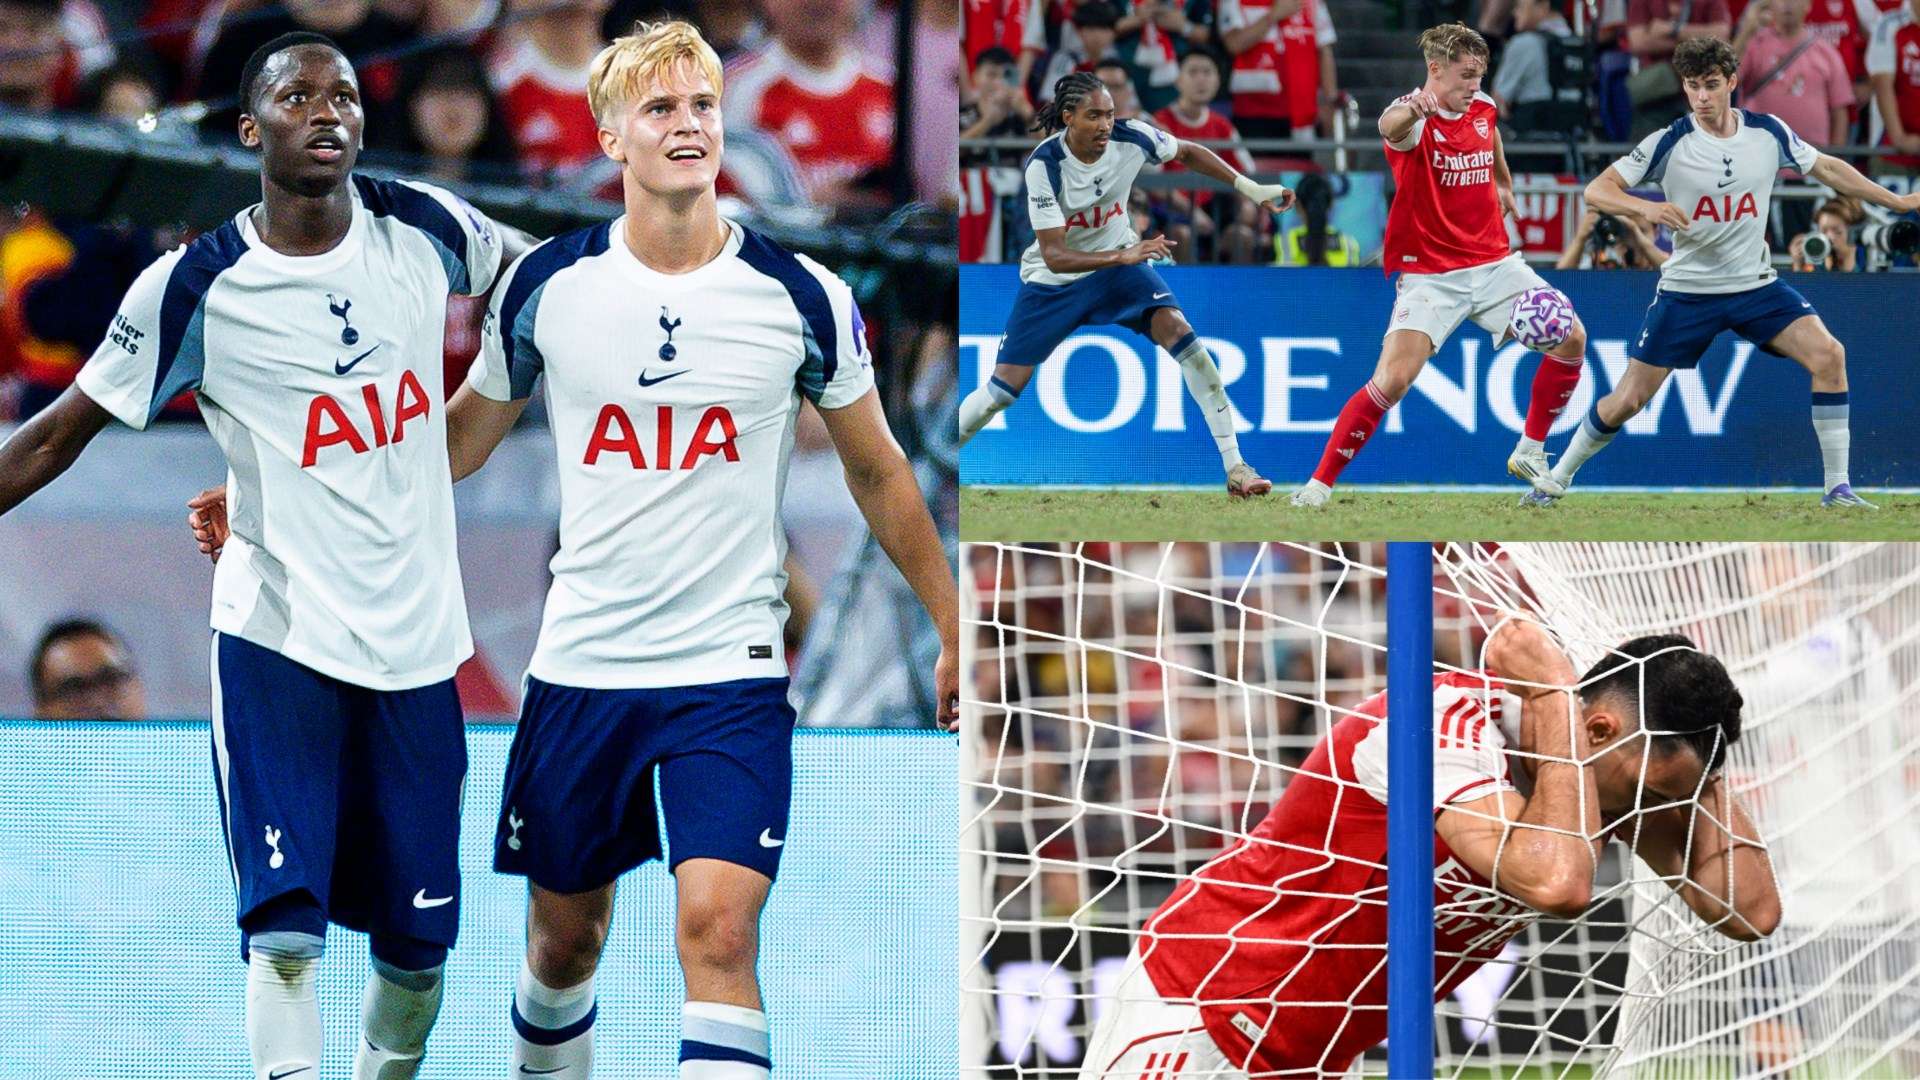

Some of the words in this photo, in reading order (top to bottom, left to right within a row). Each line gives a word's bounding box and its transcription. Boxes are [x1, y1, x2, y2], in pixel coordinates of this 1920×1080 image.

[1433, 150, 1494, 171] Emirates
[1440, 171, 1460, 187] FLY
[1460, 168, 1490, 187] BETTER
[1065, 201, 1124, 233] AIA
[1692, 191, 1758, 223] AIA
[1385, 338, 1756, 435] NOW
[301, 368, 431, 469] AIA
[582, 403, 741, 471] AIA
